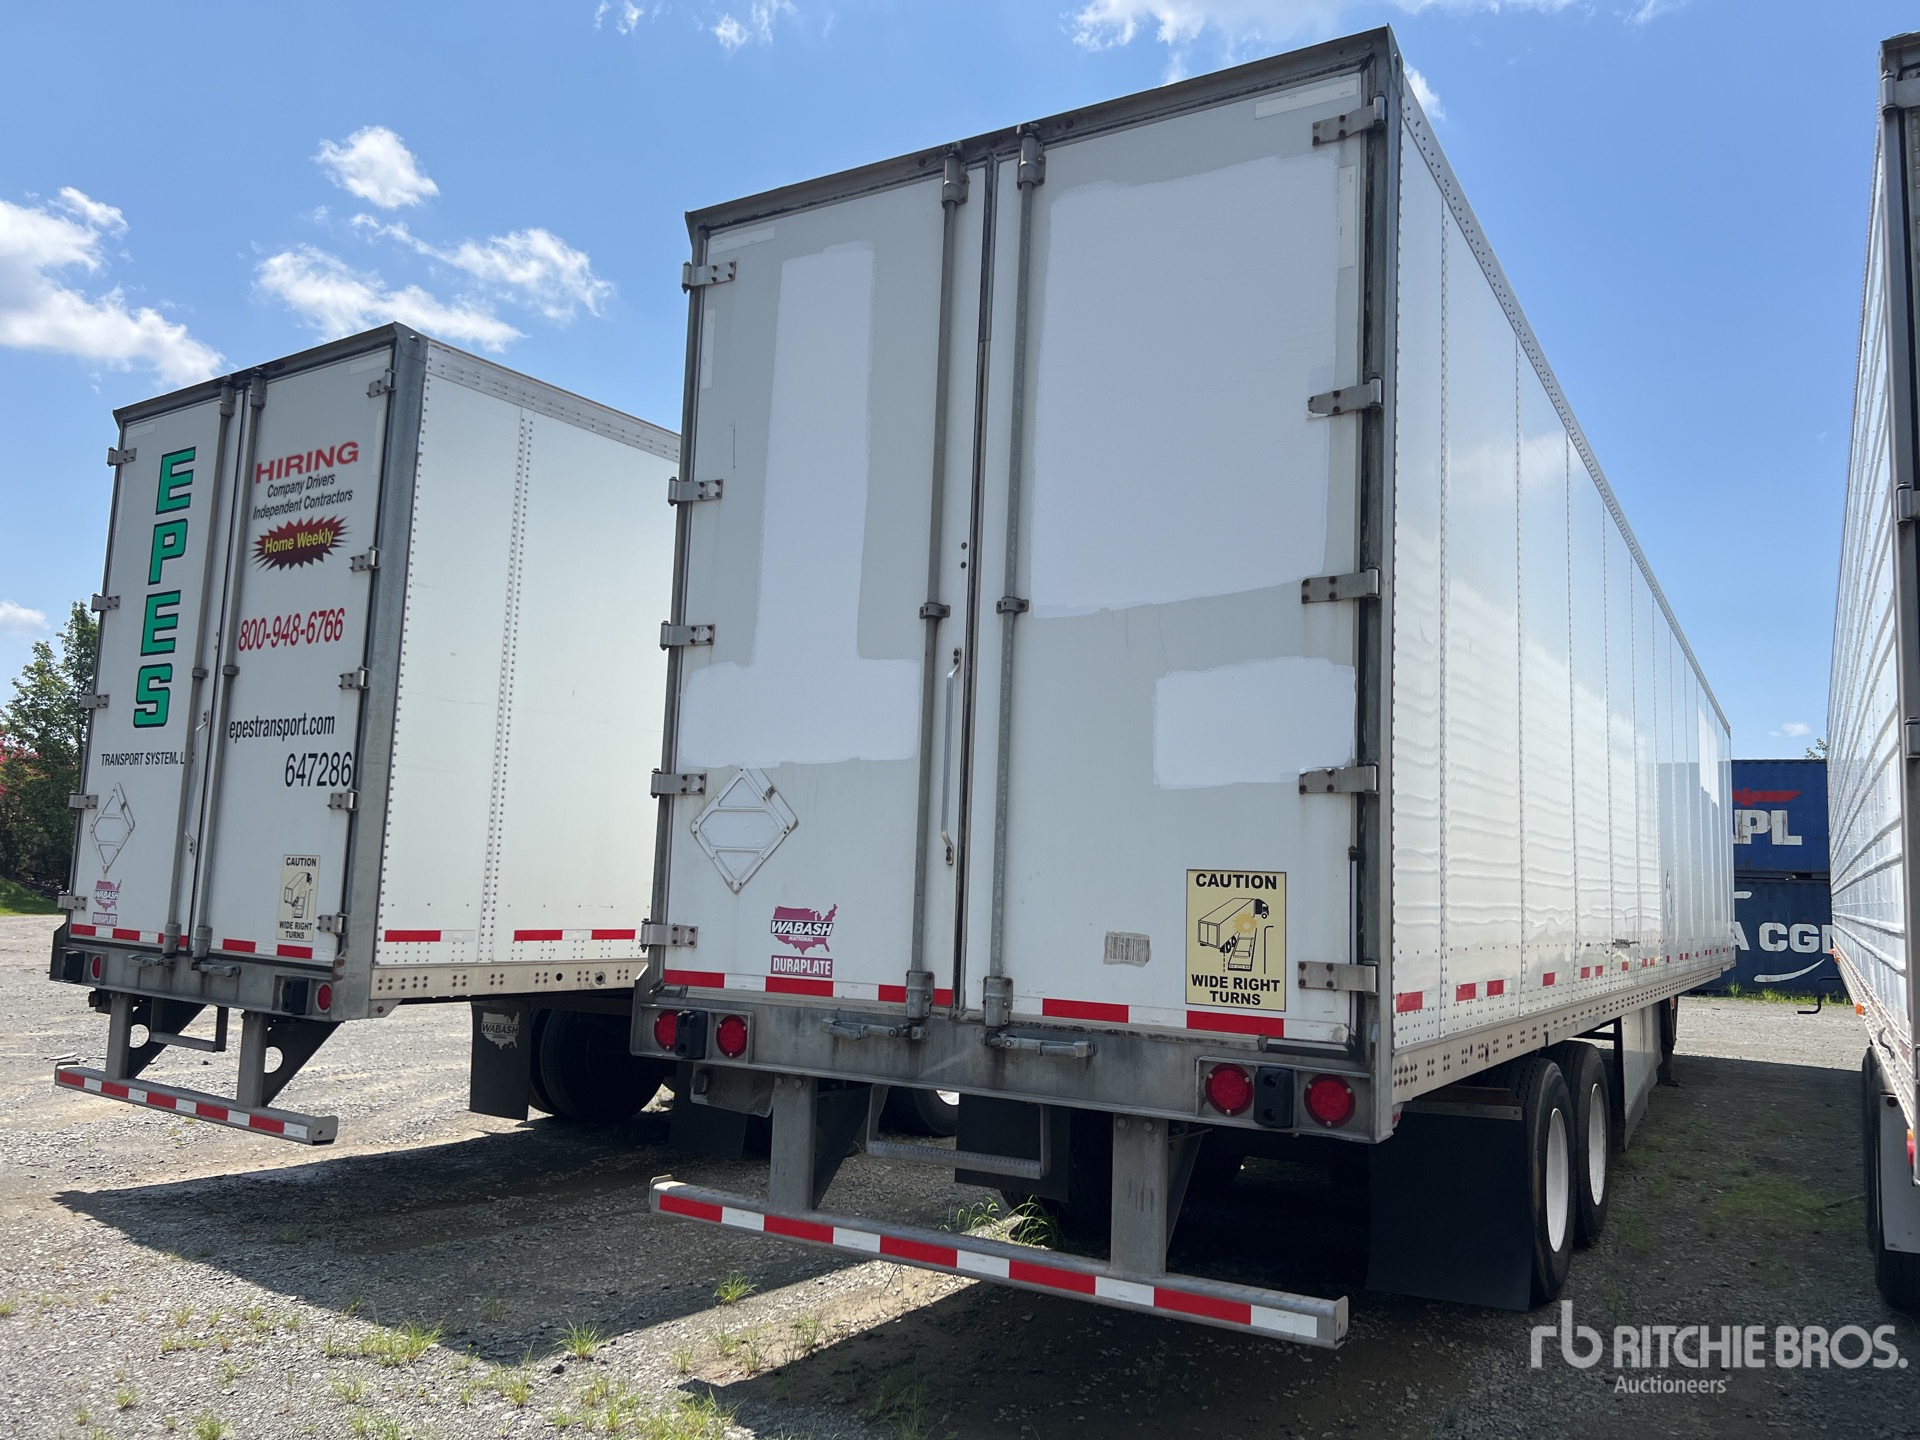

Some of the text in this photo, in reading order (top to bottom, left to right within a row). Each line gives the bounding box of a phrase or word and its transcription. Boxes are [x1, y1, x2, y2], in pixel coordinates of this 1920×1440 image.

[256, 441, 359, 484] HIRING
[267, 473, 336, 498] Company Drivers
[253, 489, 353, 520] Independent Contractors
[264, 527, 334, 554] Home Weekly
[133, 446, 196, 728] EPES
[238, 608, 346, 652] 800-948-6766
[229, 712, 335, 744] epestransport.com
[101, 752, 144, 767] TRANSPORT
[285, 751, 353, 788] 647286
[1733, 809, 1803, 846] PL
[286, 857, 317, 867] CAUTION
[1195, 873, 1277, 890] CAUTION
[279, 921, 313, 931] WIDE RIGHT
[285, 930, 305, 940] TURNS
[772, 921, 832, 935] WABASH
[773, 957, 832, 975] DURAPLATE
[1191, 974, 1280, 993] WIDE RIGHT
[1209, 990, 1261, 1006] TURNS
[482, 1024, 517, 1034] WABASH
